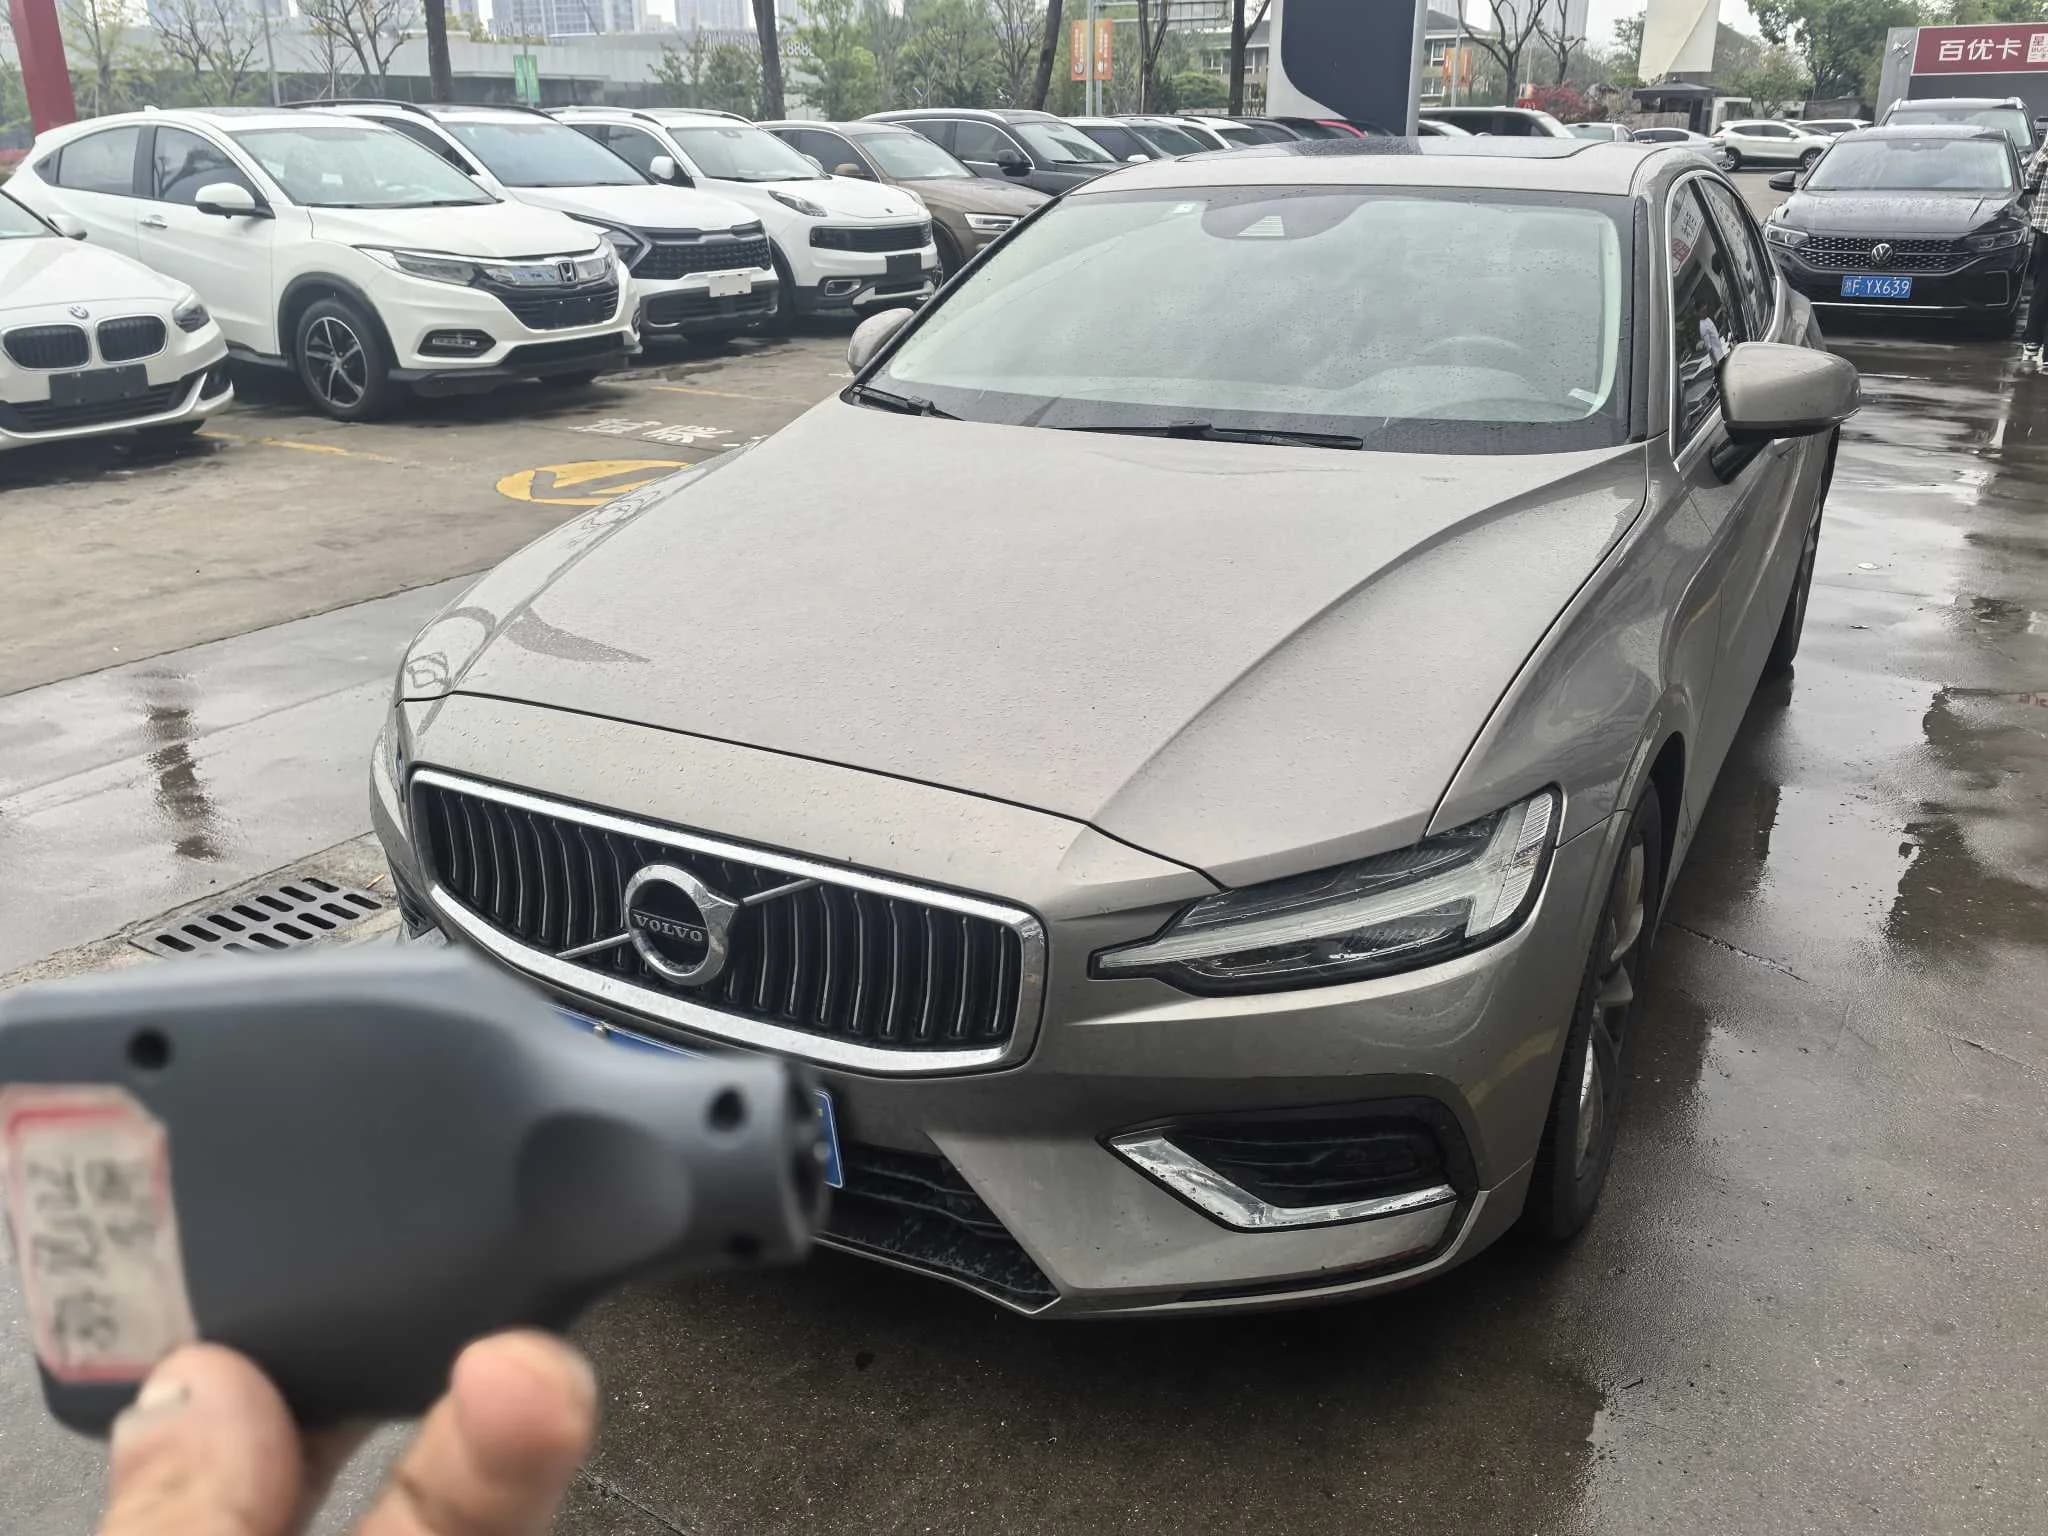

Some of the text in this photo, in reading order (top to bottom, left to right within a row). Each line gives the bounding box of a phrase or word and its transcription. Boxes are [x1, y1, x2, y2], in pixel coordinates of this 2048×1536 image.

[1938, 38, 2022, 61] 百优卡
[1867, 279, 1910, 294] YX639
[633, 914, 703, 942] VOLVO
